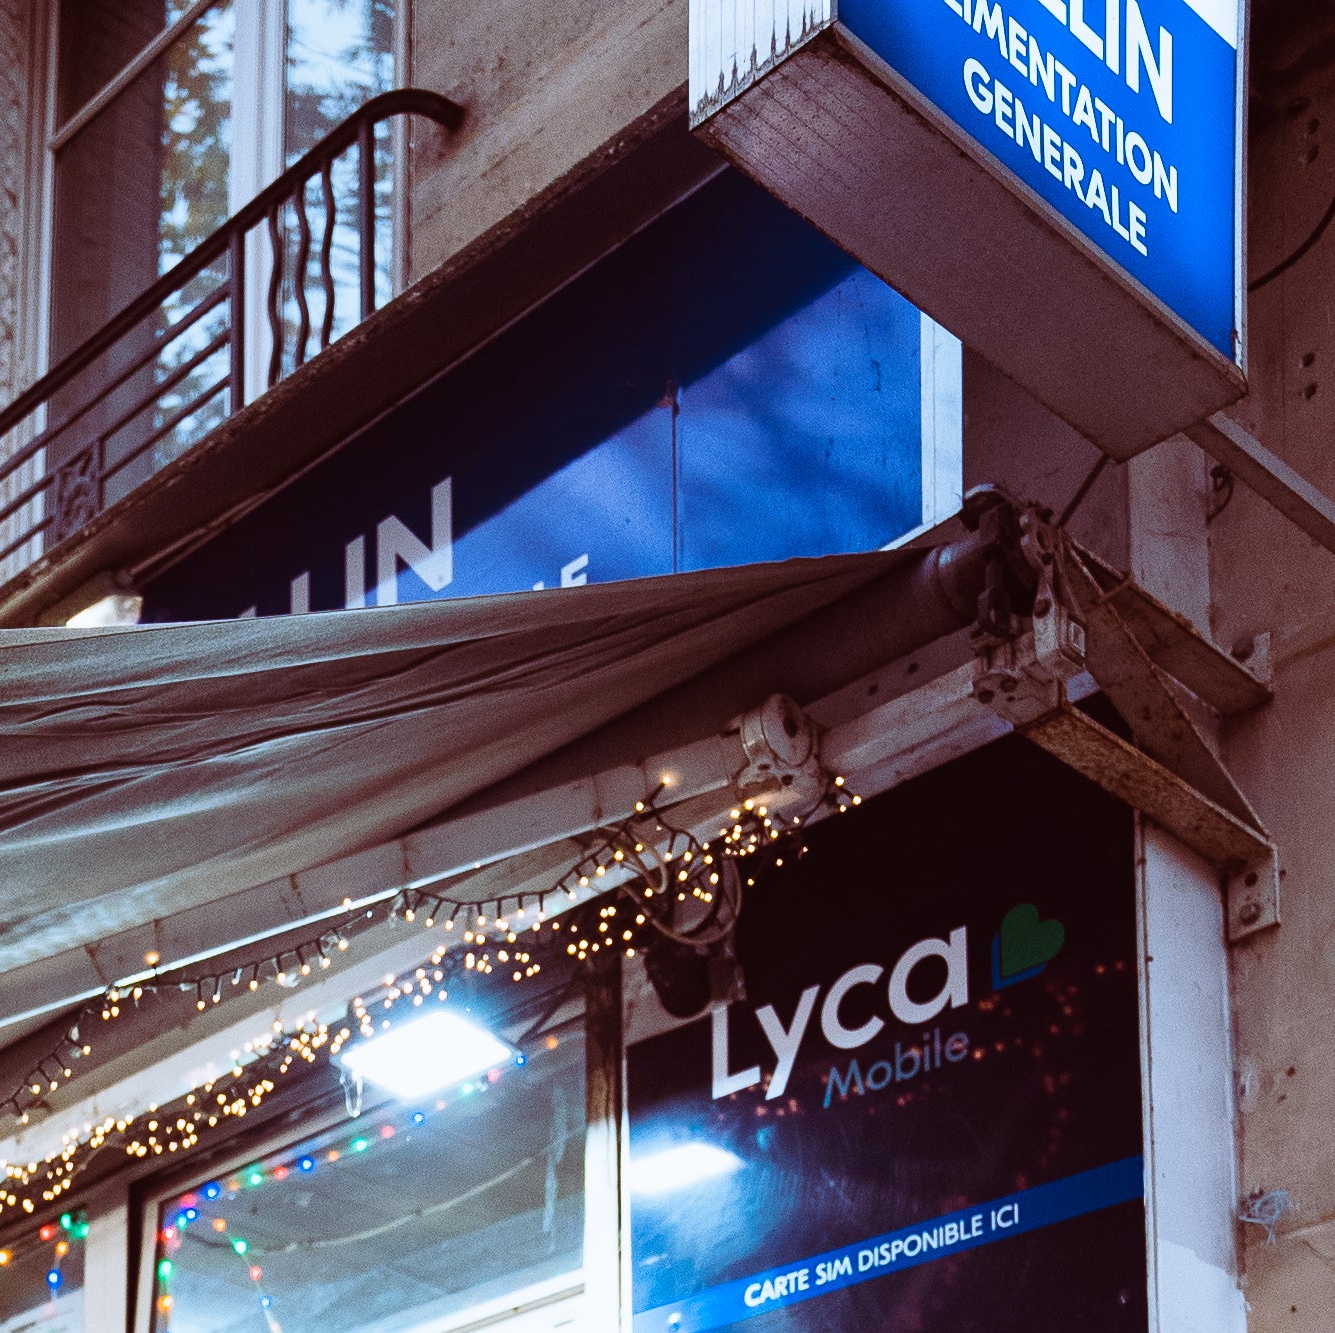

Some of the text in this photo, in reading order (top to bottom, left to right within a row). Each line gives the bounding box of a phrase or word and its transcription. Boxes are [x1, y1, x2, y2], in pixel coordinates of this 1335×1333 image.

[963, 57, 1148, 257] GENERALE
[711, 925, 969, 1101] Lyca
[823, 1029, 970, 1109] Mobile
[744, 1203, 1020, 1308] CARTE SIM DISPONIBLE ICI
